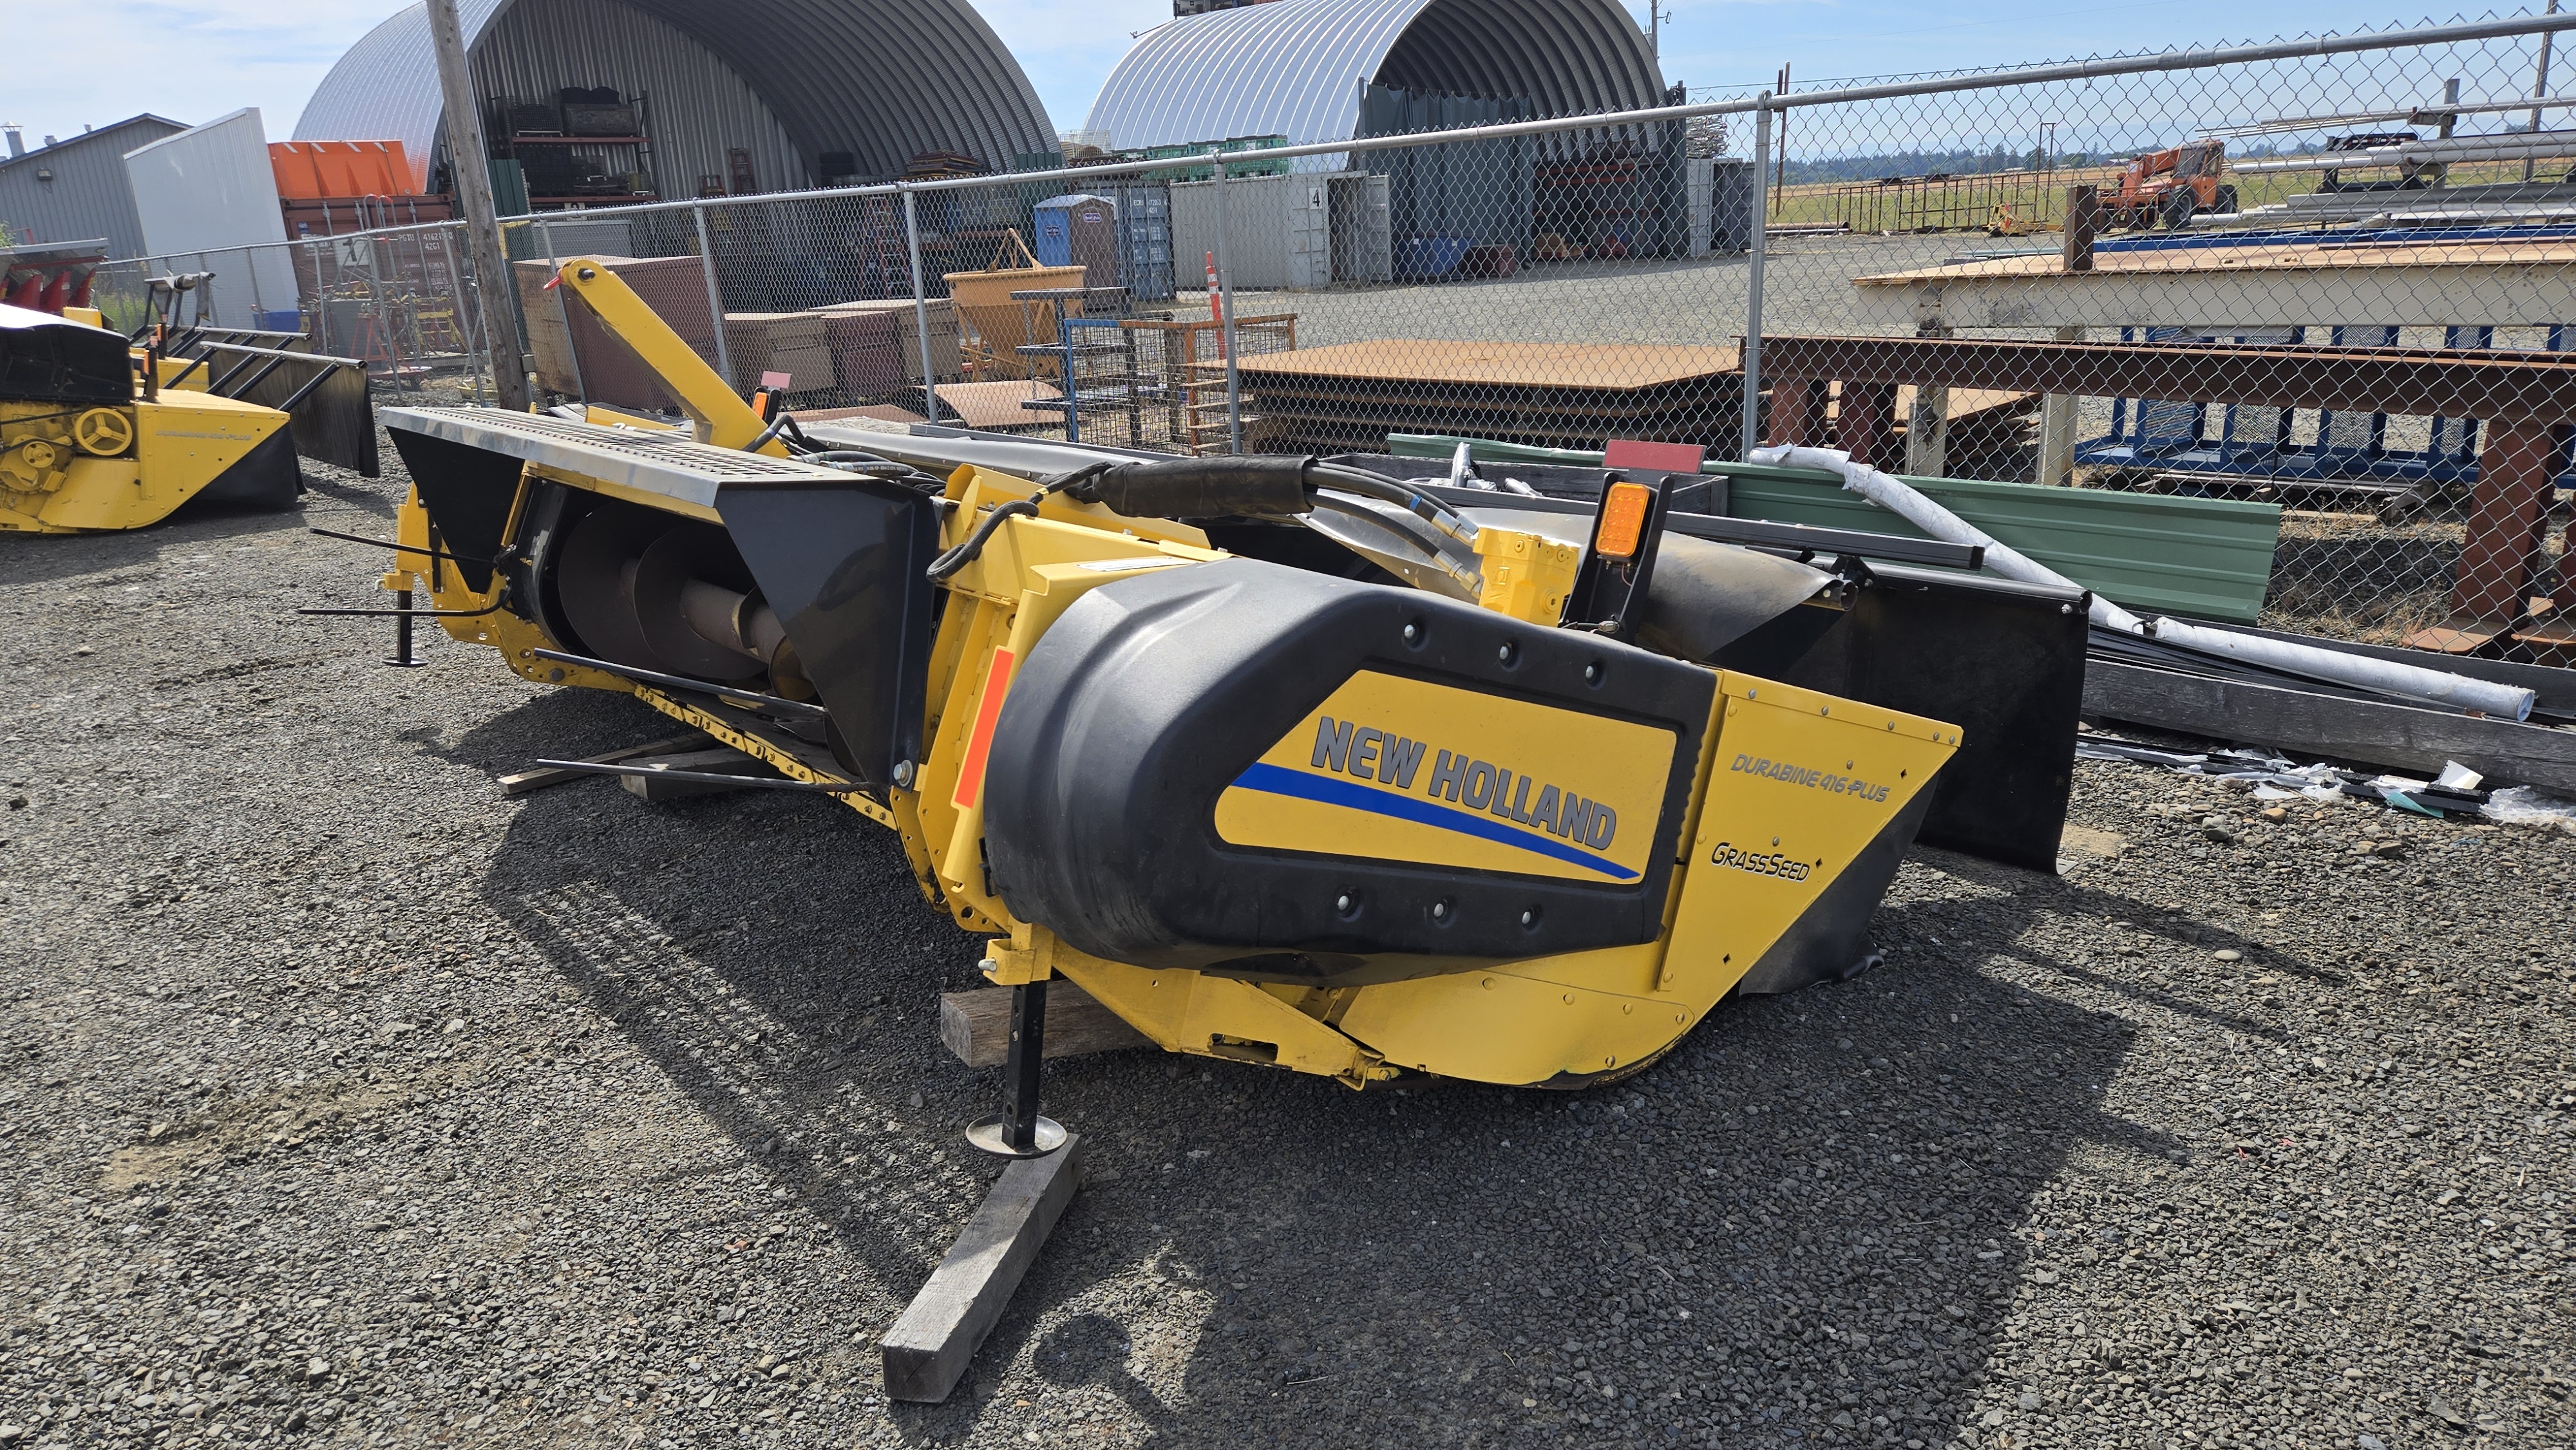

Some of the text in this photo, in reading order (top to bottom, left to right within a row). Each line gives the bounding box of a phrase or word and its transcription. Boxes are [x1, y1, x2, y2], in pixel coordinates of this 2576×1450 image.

[1312, 189, 1320, 207] 4
[1311, 715, 1616, 851] NEW HOLLAND
[1730, 753, 1823, 788] DURABINE
[1820, 773, 1849, 793] 416
